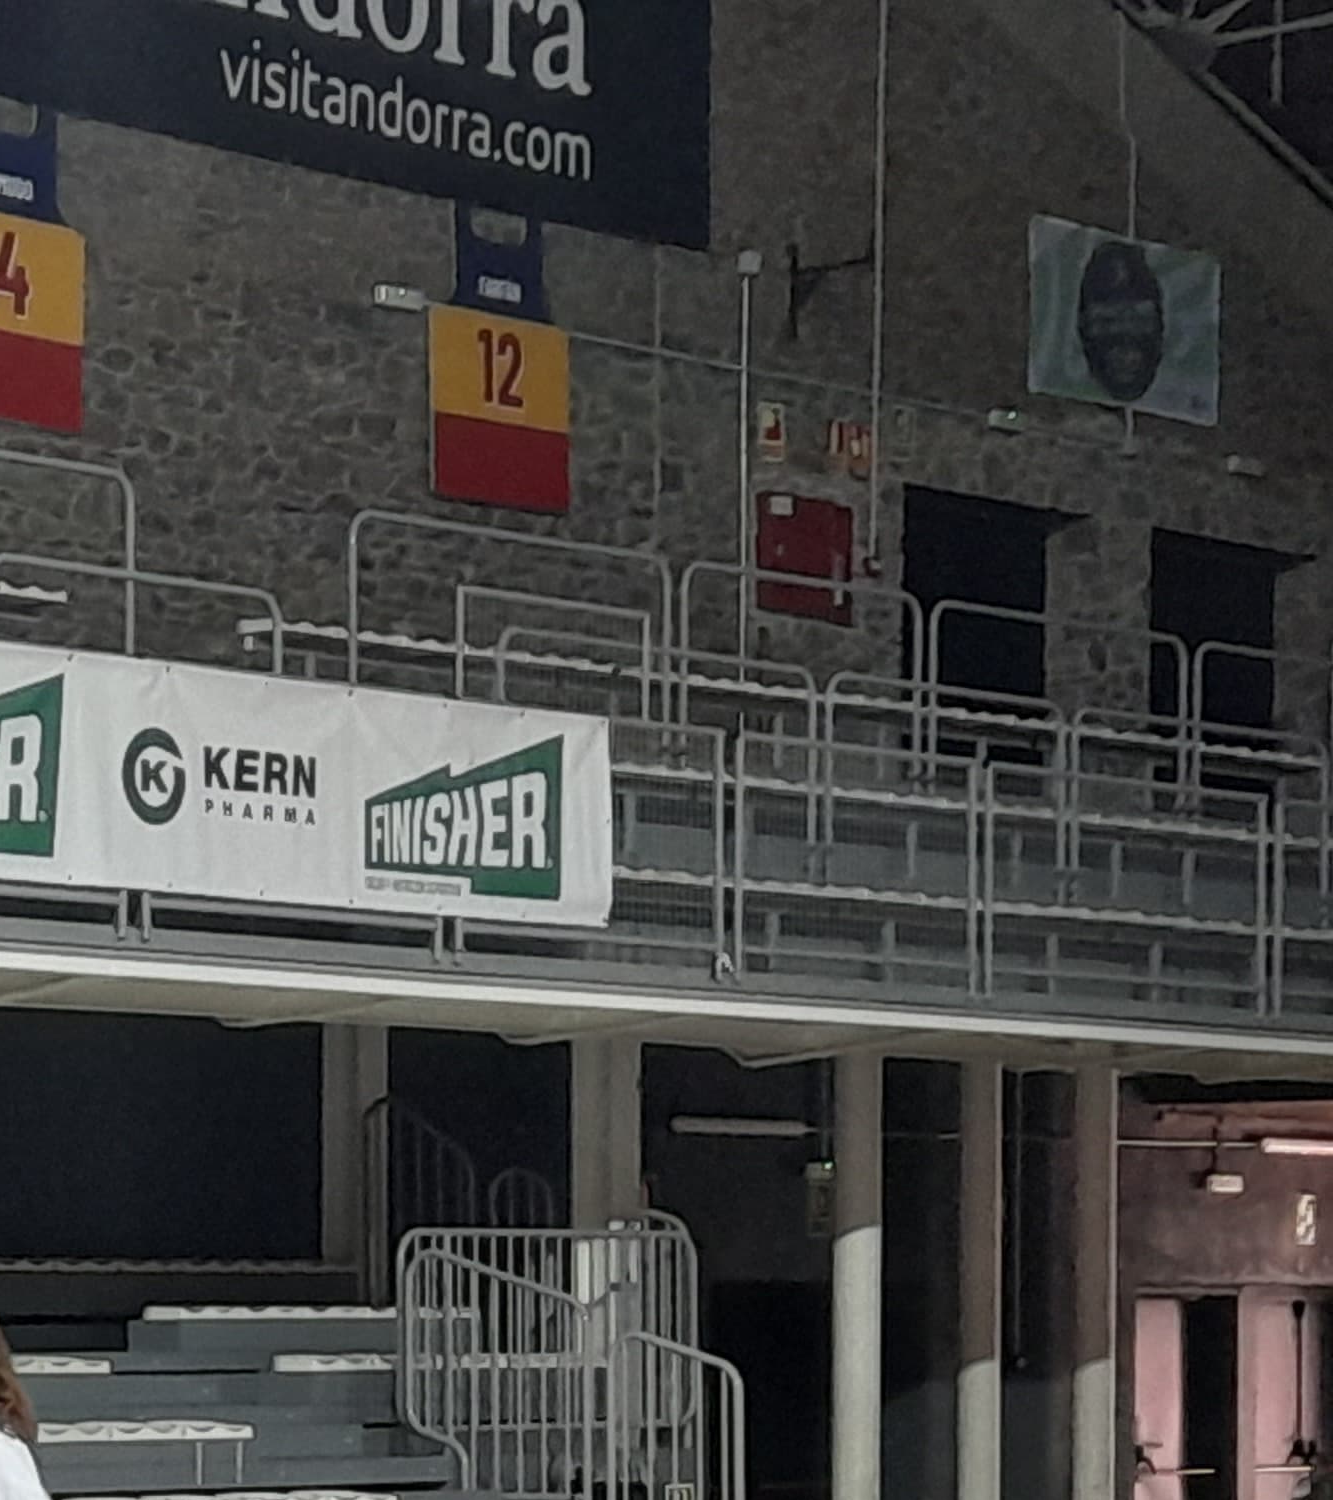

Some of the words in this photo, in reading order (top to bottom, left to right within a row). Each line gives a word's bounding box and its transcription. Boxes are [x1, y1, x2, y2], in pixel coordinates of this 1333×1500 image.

[220, 39, 592, 181] visitandorra.com
[478, 328, 525, 410] 12
[202, 744, 317, 800] KERN
[204, 799, 317, 827] PHARMA
[371, 770, 546, 871] FINISHER
